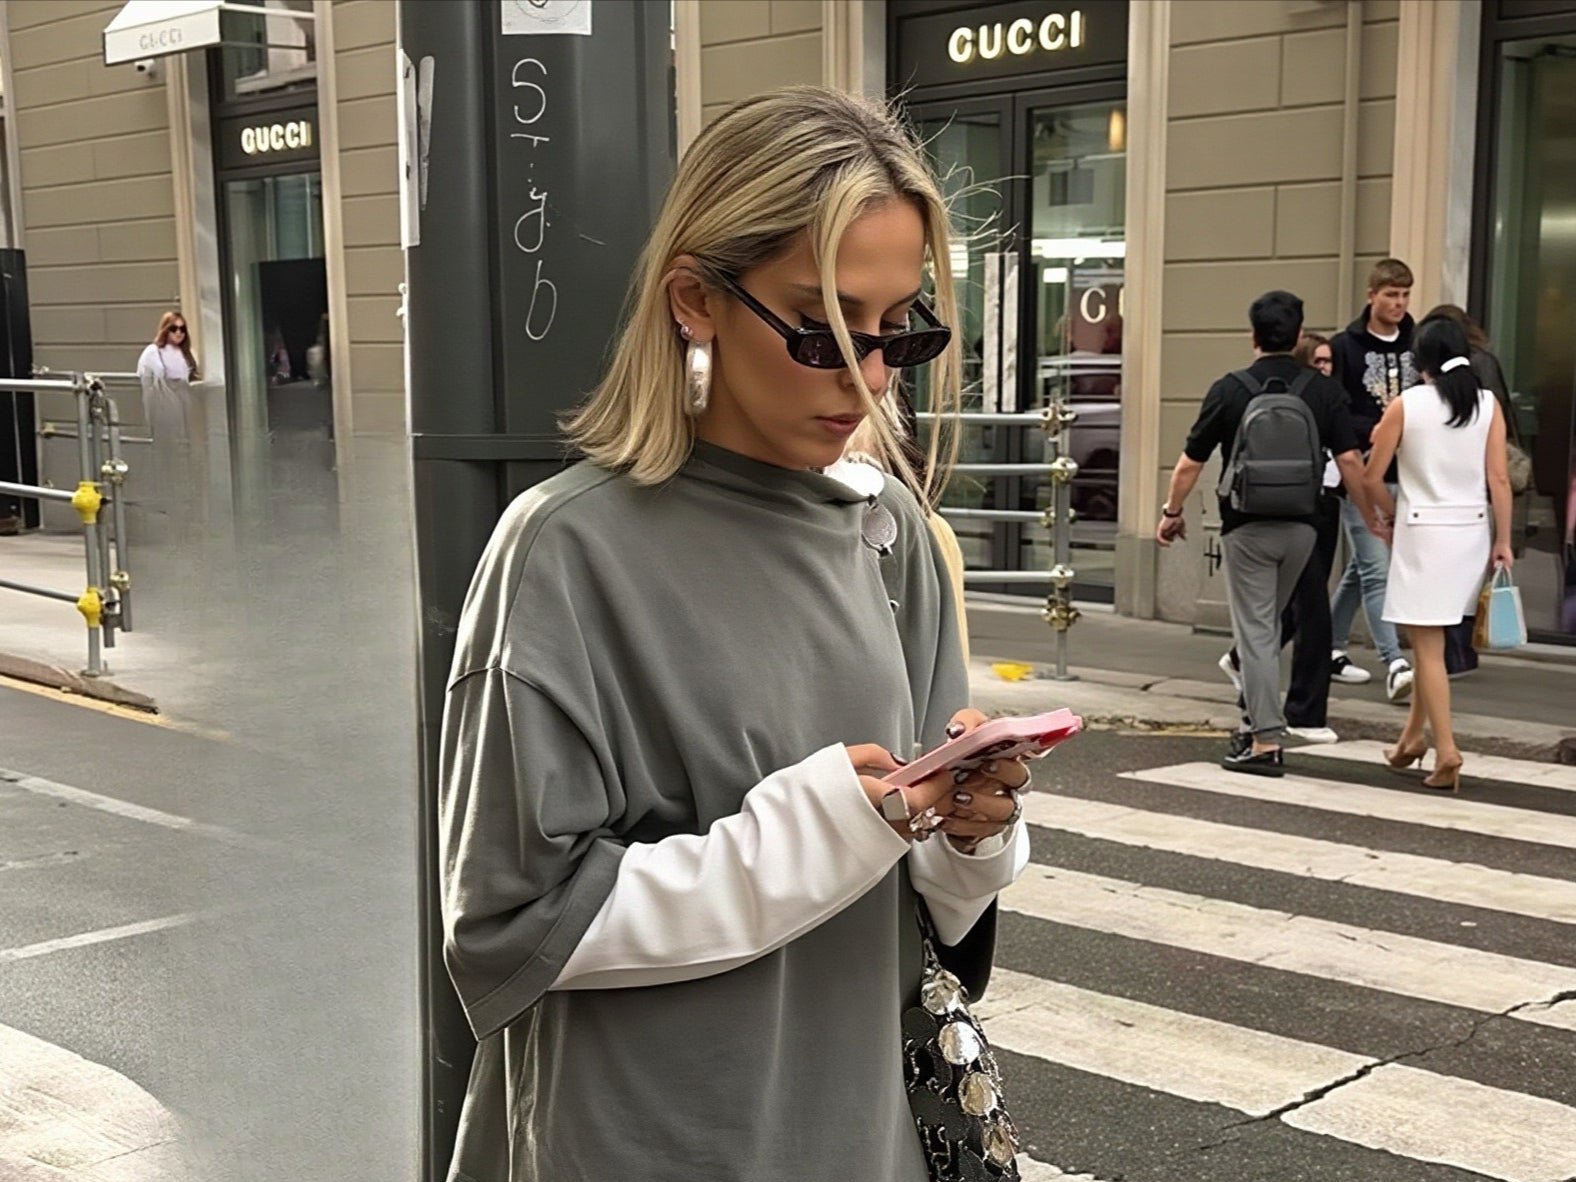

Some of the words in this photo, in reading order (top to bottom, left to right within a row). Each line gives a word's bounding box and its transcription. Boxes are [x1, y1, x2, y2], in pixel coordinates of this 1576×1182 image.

[947, 10, 1084, 63] GUCCI
[240, 120, 311, 154] GUCCI
[1080, 286, 1124, 324] G
